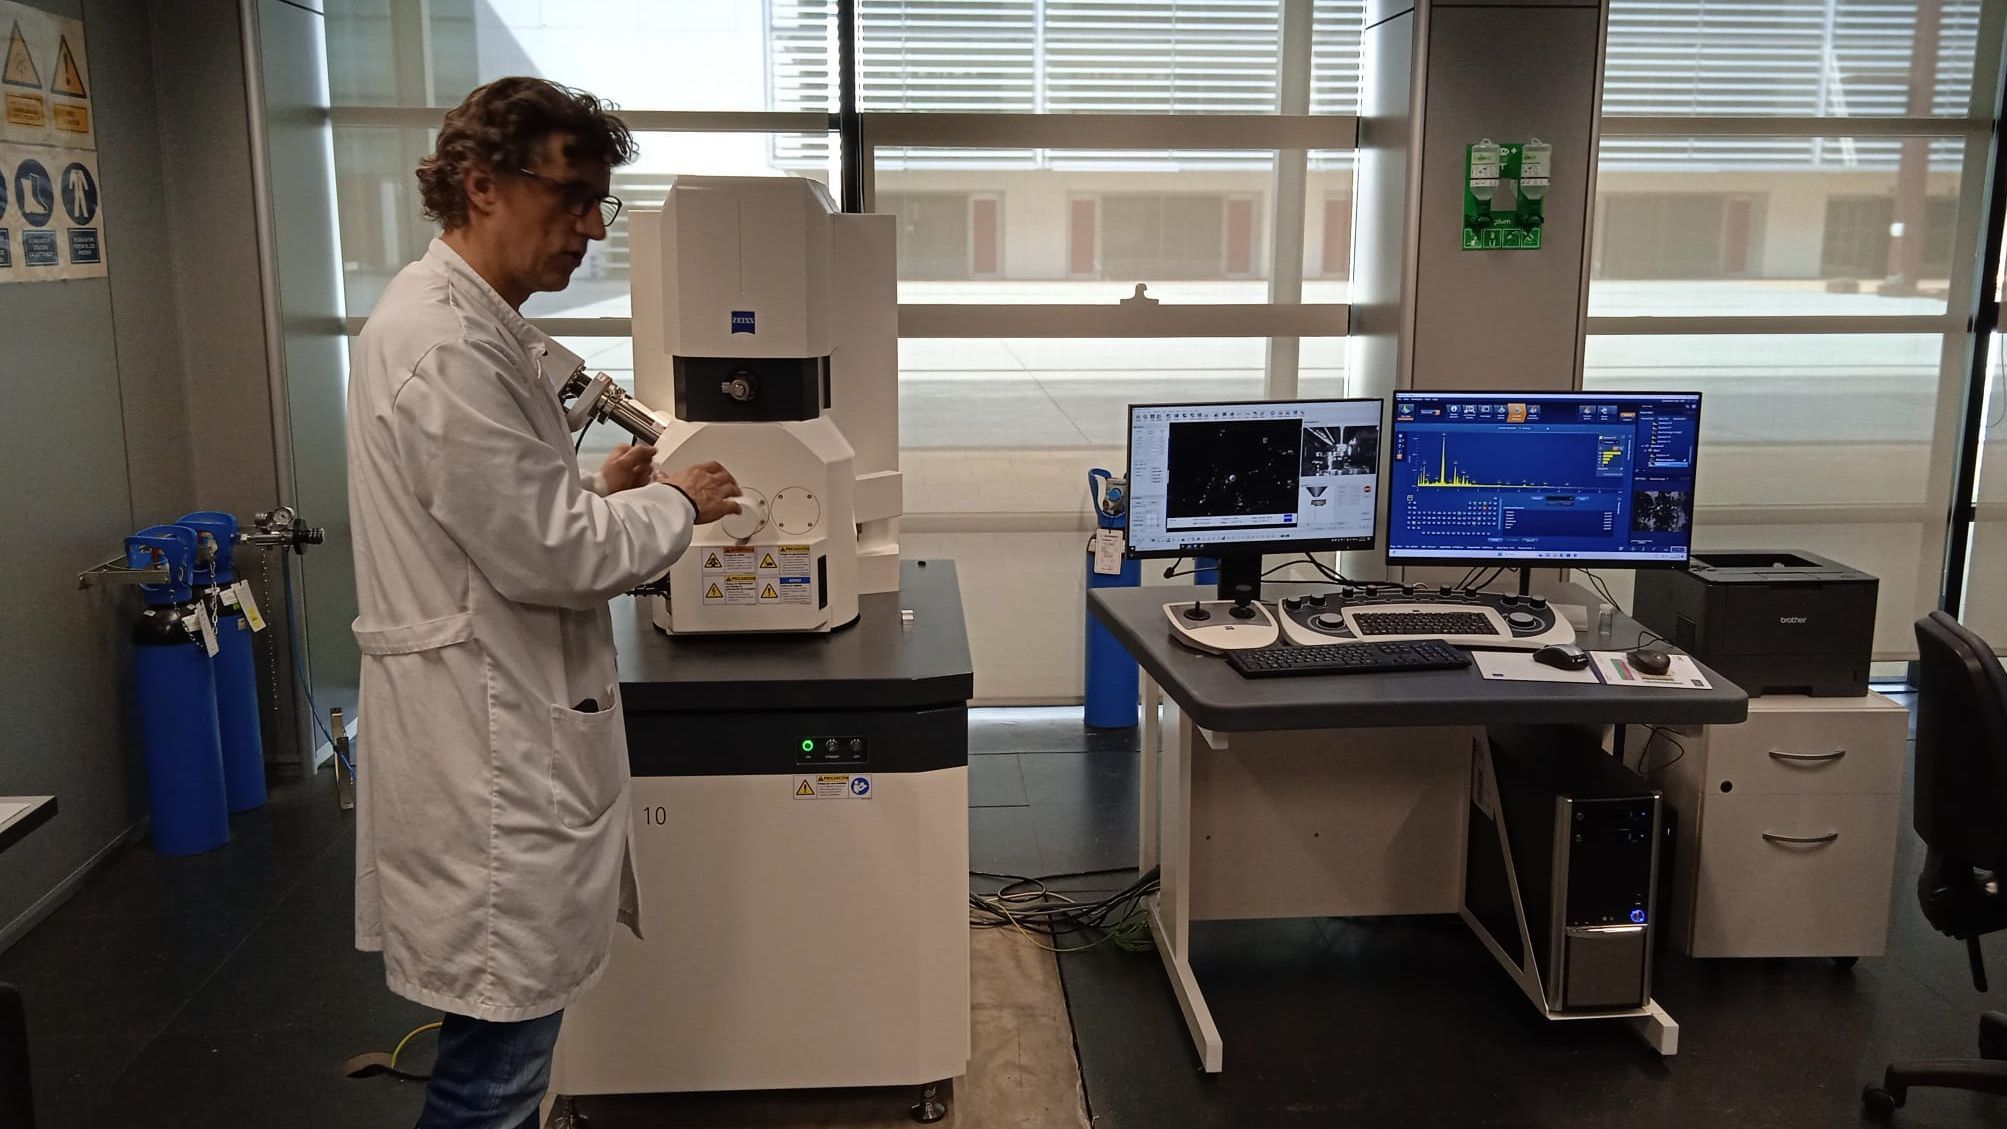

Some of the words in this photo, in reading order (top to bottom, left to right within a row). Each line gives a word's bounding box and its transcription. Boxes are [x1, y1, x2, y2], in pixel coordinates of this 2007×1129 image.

[732, 316, 754, 324] ZEISS
[1780, 616, 1807, 624] brother
[643, 806, 667, 826] 10
